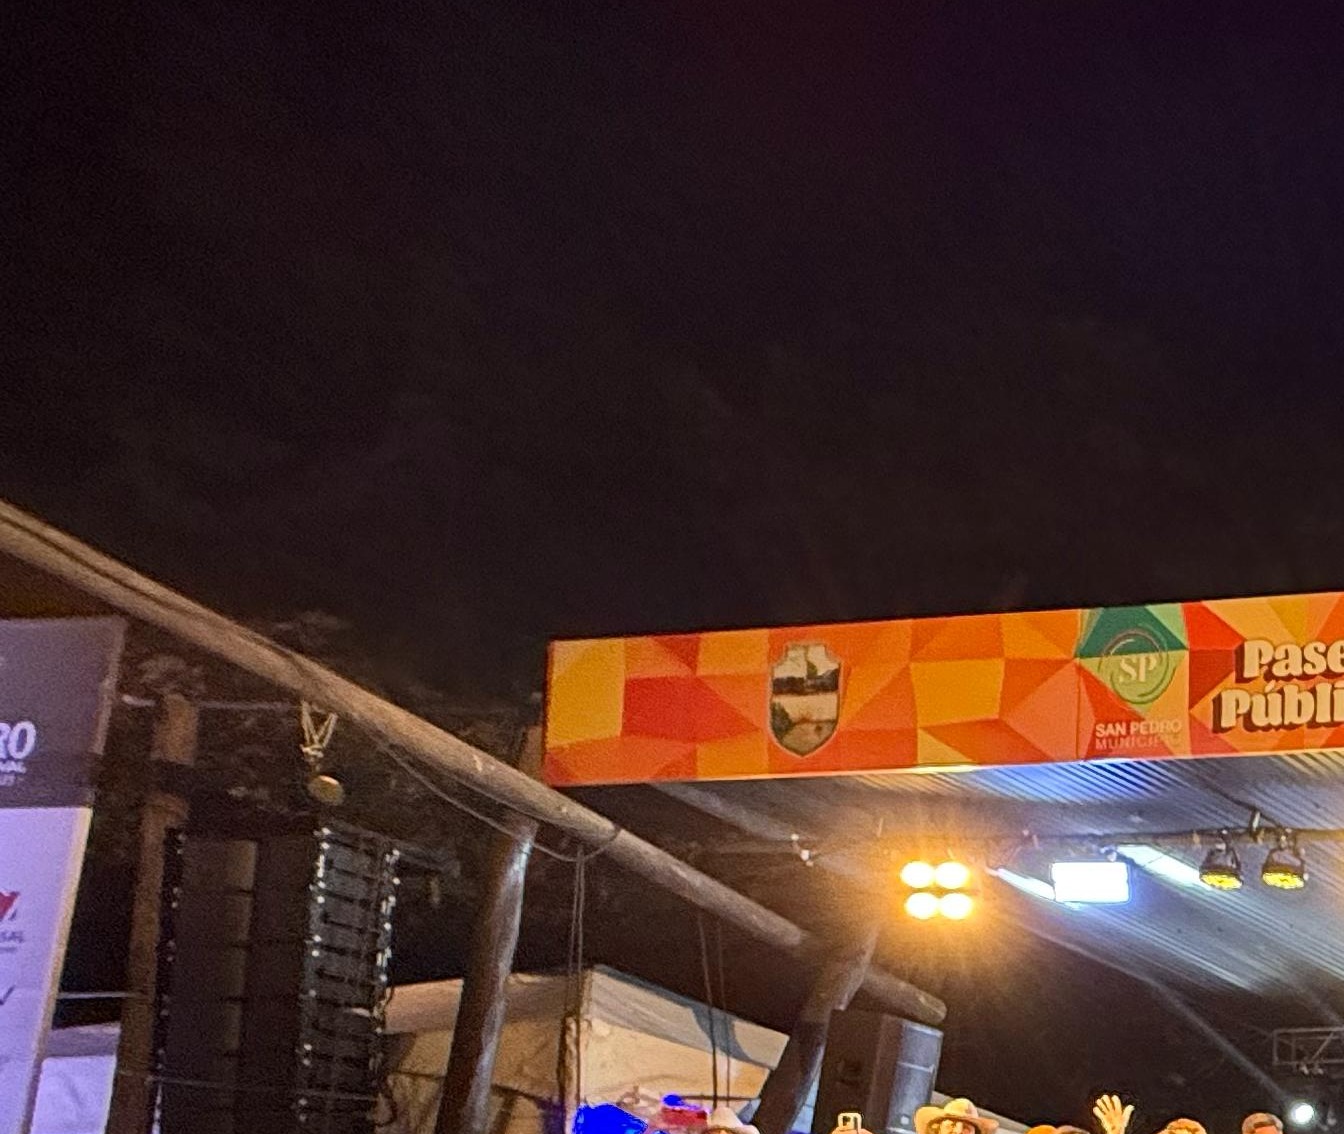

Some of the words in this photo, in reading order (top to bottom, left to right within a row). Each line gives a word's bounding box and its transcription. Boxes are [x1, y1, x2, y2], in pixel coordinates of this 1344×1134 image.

[1118, 655, 1158, 684] SP
[1095, 722, 1127, 738] SAN
[1129, 718, 1182, 736] PEDRO
[1095, 733, 1181, 750] MUNICIPO
